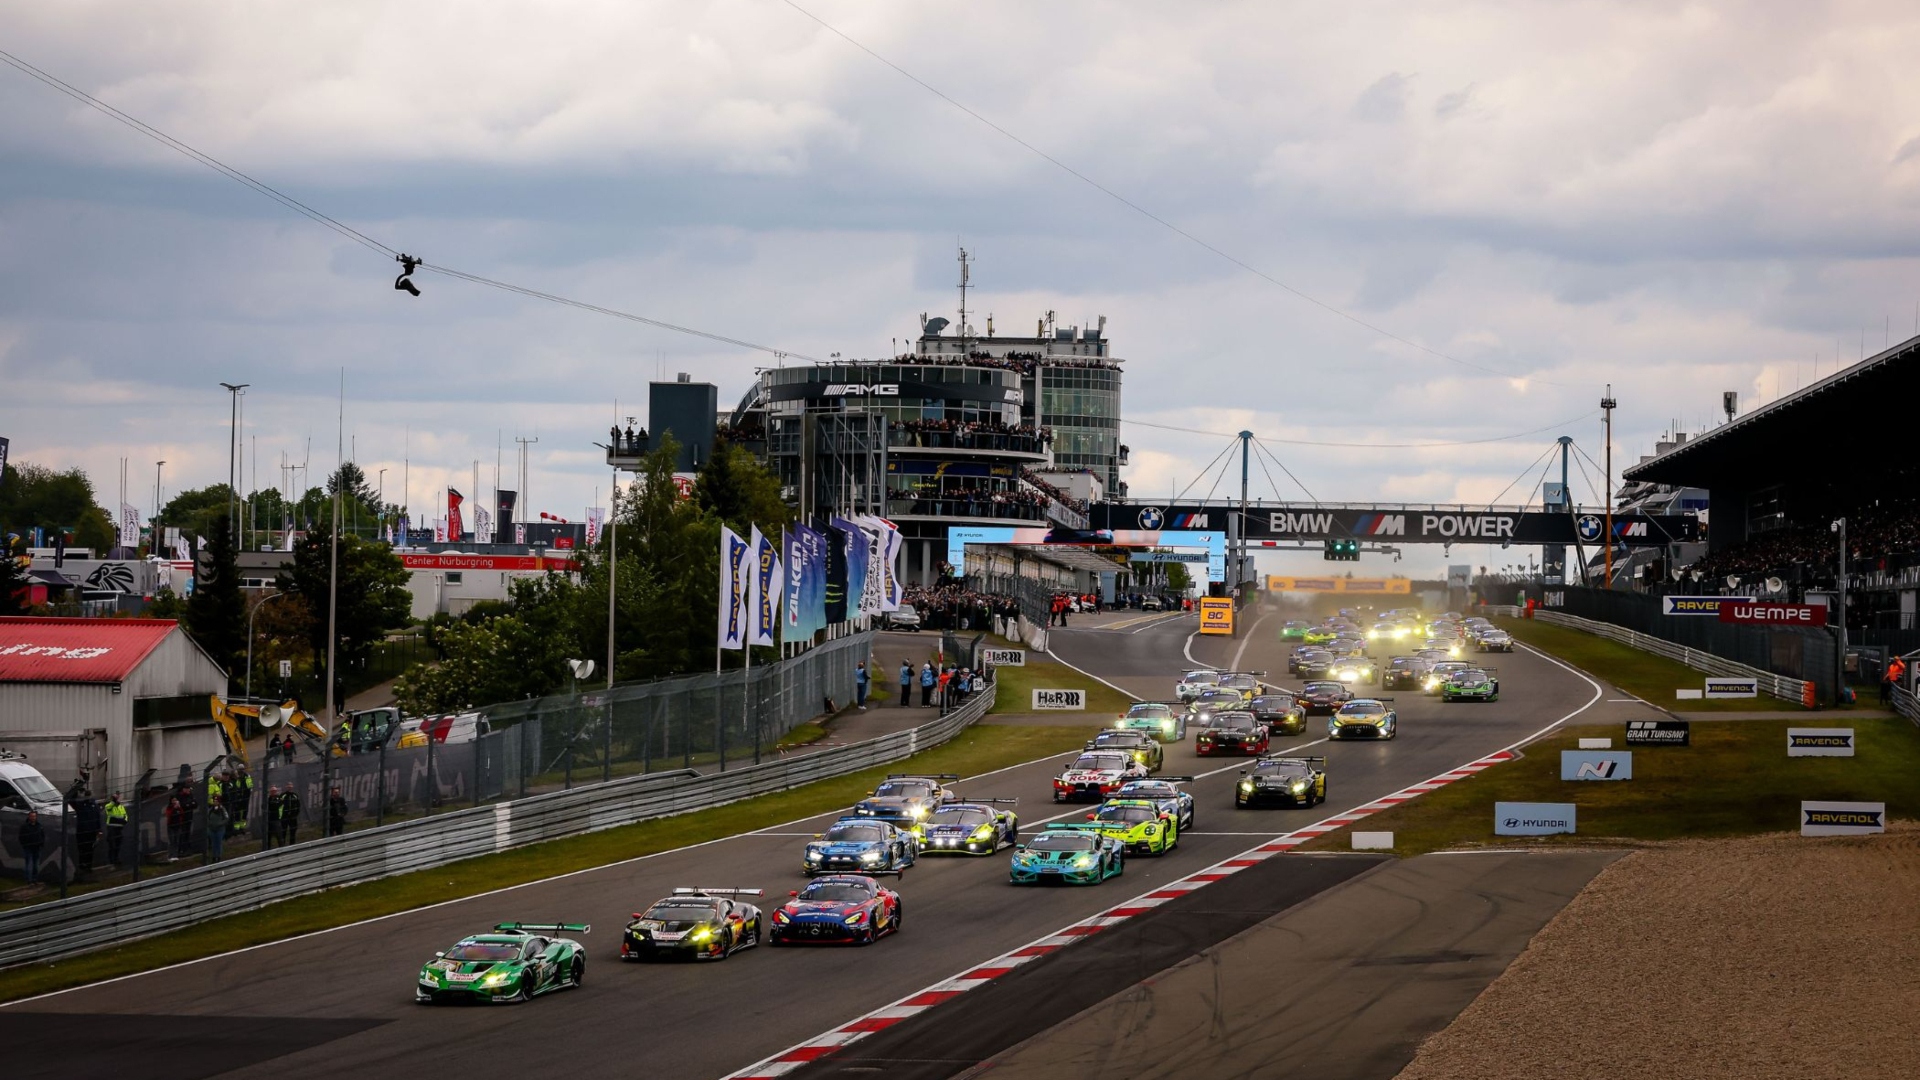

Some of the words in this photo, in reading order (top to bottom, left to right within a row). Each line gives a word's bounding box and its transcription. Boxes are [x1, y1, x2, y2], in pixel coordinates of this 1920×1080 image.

[842, 384, 899, 395] AMG
[1270, 512, 1333, 533] BMW
[1422, 515, 1514, 537] POWER
[406, 556, 435, 565] Center
[440, 556, 494, 568] Nürburgring
[1734, 606, 1811, 621] WEMPE
[1627, 730, 1649, 738] GRAN
[1650, 730, 1685, 739] TURISMO
[1523, 820, 1567, 828] HYUNDAI
[1812, 814, 1875, 823] RAVENOL
